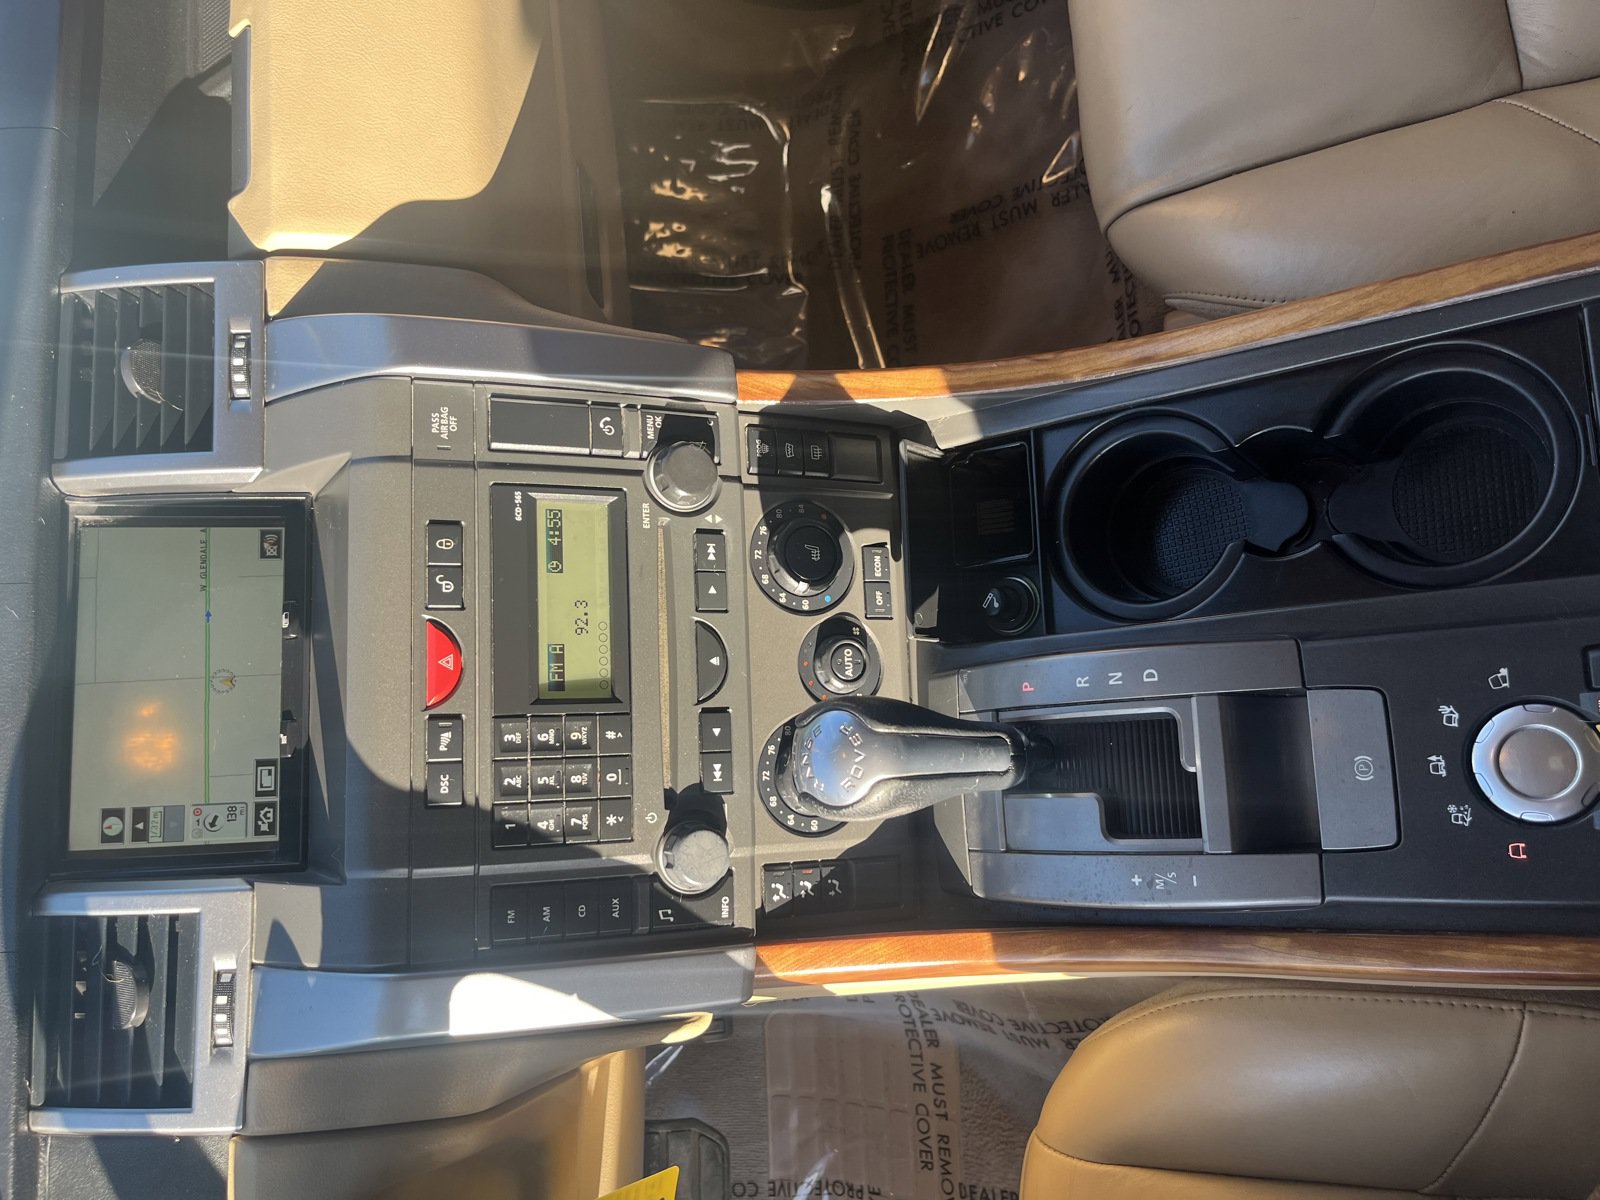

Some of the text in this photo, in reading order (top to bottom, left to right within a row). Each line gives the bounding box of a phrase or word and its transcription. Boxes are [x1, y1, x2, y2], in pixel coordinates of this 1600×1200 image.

[991, 198, 1038, 231] MUST
[431, 413, 440, 433] PASS
[655, 416, 662, 428] OK
[776, 509, 782, 518] 80
[798, 504, 805, 514] 84
[547, 510, 561, 545] 4:55
[760, 526, 767, 536] 76
[754, 549, 762, 559] 72
[200, 540, 208, 579] GLENDALE
[762, 574, 769, 584] 68
[200, 584, 207, 592] W
[779, 593, 786, 603] 64
[802, 600, 809, 610] 60
[575, 600, 588, 636] 92.3
[550, 644, 564, 682] FM A
[844, 649, 853, 676] AUTO
[1109, 672, 1122, 685] N
[1143, 668, 1159, 682] D
[1022, 682, 1034, 692] P
[1076, 676, 1089, 688] R
[785, 726, 792, 735] 80
[504, 734, 515, 742] 3
[537, 733, 548, 741] 6
[571, 732, 581, 740] 9
[768, 745, 775, 755] 76
[571, 775, 582, 784] 8
[606, 773, 617, 781] 0
[763, 771, 770, 781] 72
[440, 774, 449, 794] DSC
[504, 777, 516, 786] 2
[770, 796, 777, 807] 68
[226, 806, 237, 822] 138
[239, 806, 245, 816] mi
[571, 818, 582, 826] 7
[788, 814, 795, 825] 64
[537, 821, 548, 830] 4
[811, 820, 818, 830] 60
[543, 906, 550, 922] AM
[578, 904, 585, 918] CD
[508, 910, 515, 924] FM
[929, 1062, 948, 1121] MUST
[915, 1103, 935, 1172] COVER
